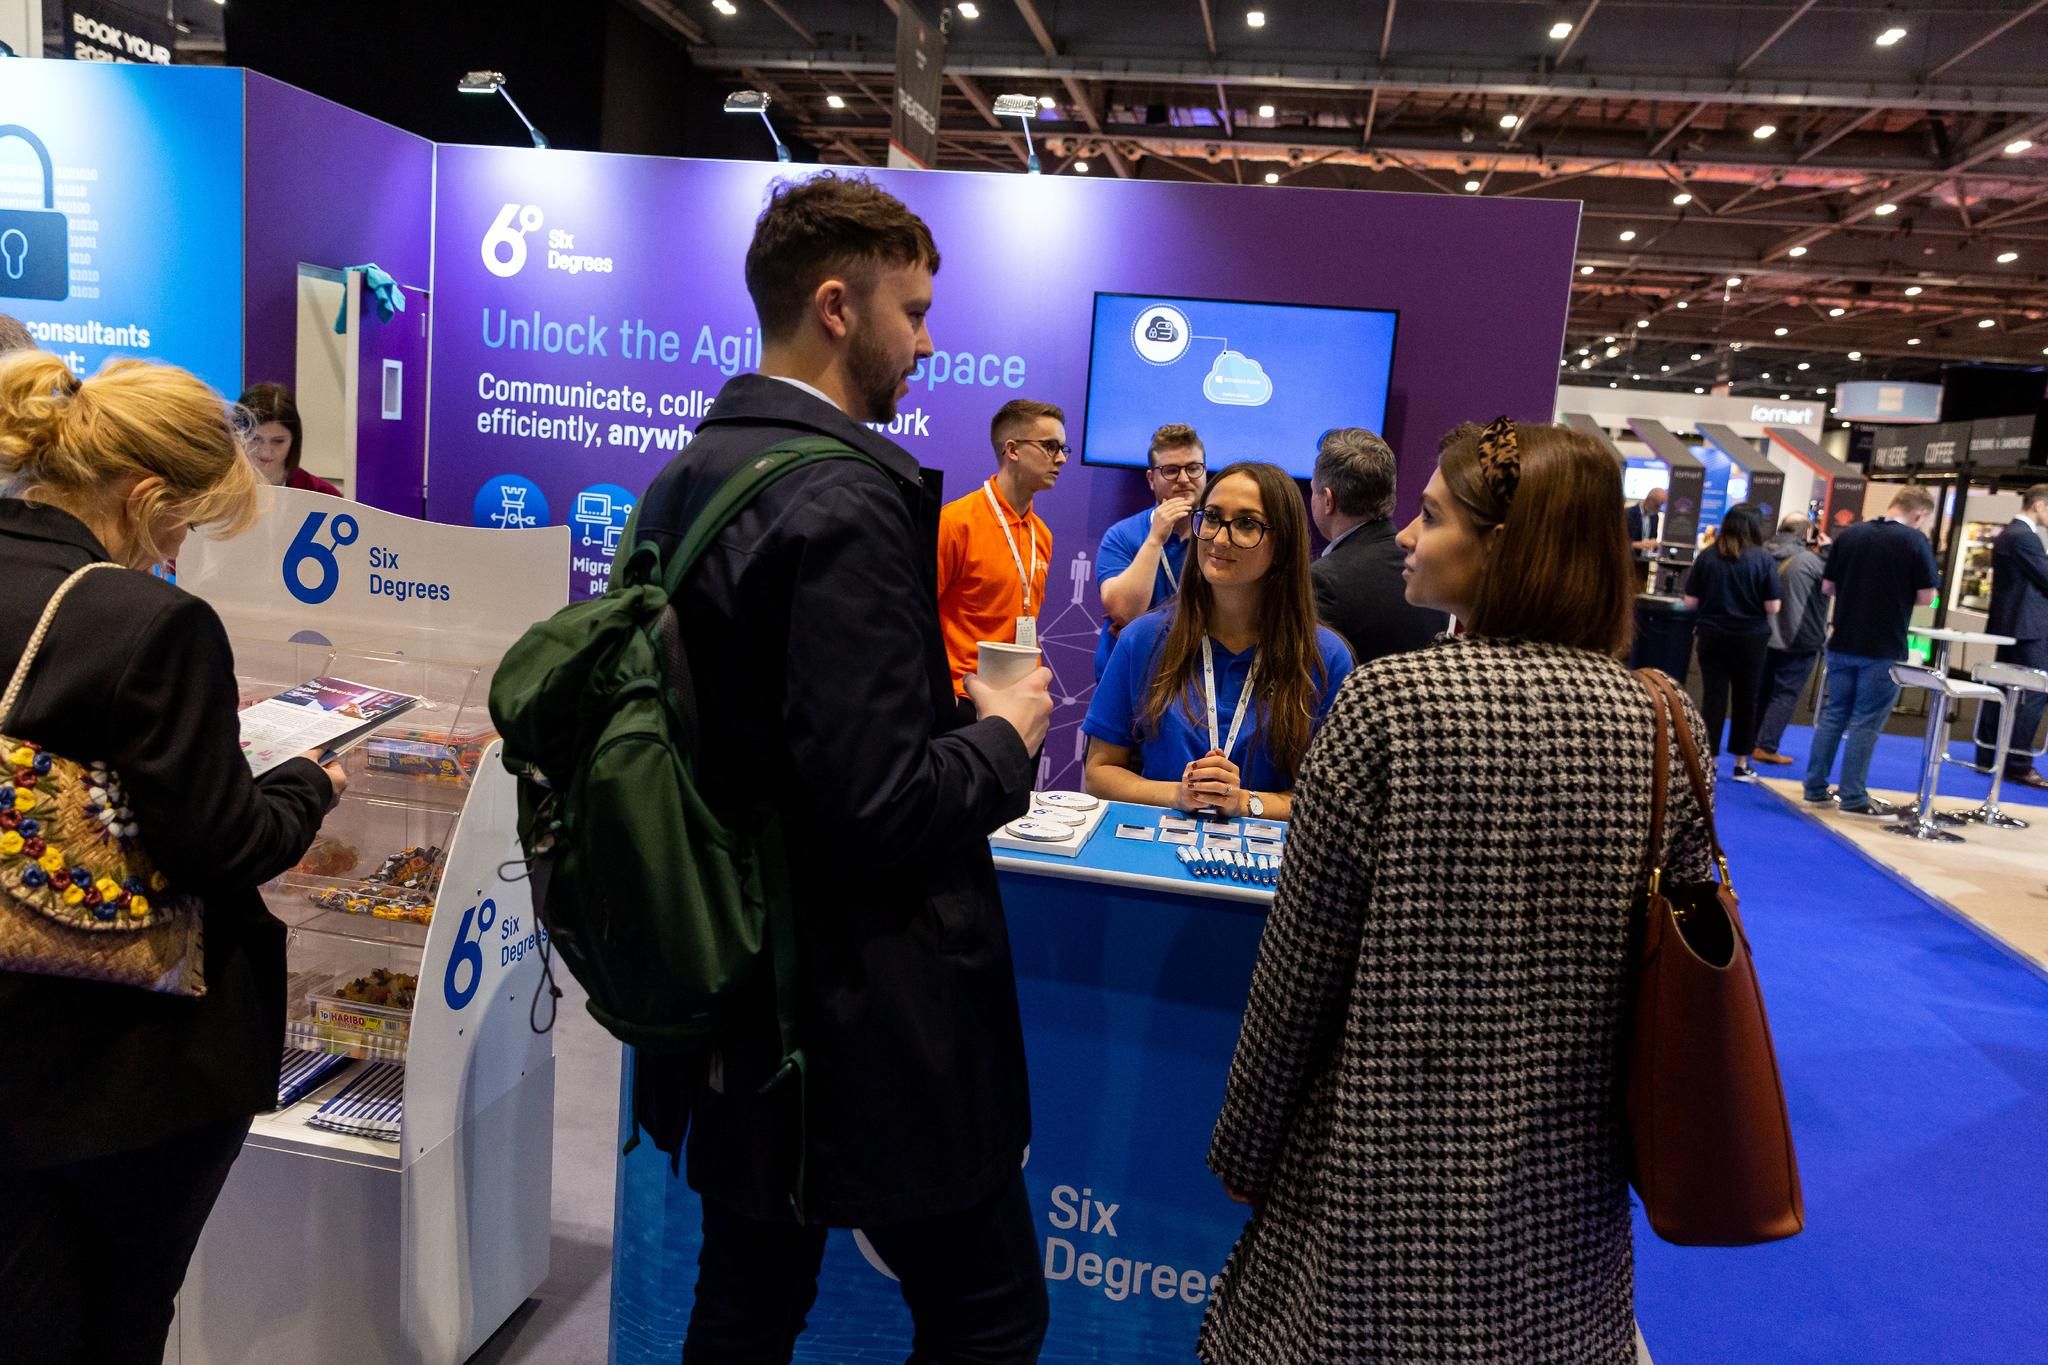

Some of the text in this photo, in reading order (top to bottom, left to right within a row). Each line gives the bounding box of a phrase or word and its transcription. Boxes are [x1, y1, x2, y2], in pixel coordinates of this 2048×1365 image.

[73, 12, 171, 65] BOOK YOUR
[548, 229, 575, 249] Six
[548, 250, 613, 274] Degrees
[26, 320, 151, 348] consultants
[482, 308, 608, 357] Unlock
[620, 319, 680, 363] the
[478, 372, 653, 417] Communicate,
[1750, 404, 1813, 425] iomart
[477, 408, 697, 453] efficiently, anywh
[1924, 441, 1956, 465] COFFEE
[369, 546, 399, 570] Six
[573, 556, 613, 576] Migra
[369, 574, 450, 601] Degrees
[501, 916, 520, 940] Six
[501, 927, 548, 967] Degrees
[331, 1012, 365, 1026] HARIBO
[1048, 1184, 1120, 1237] Six
